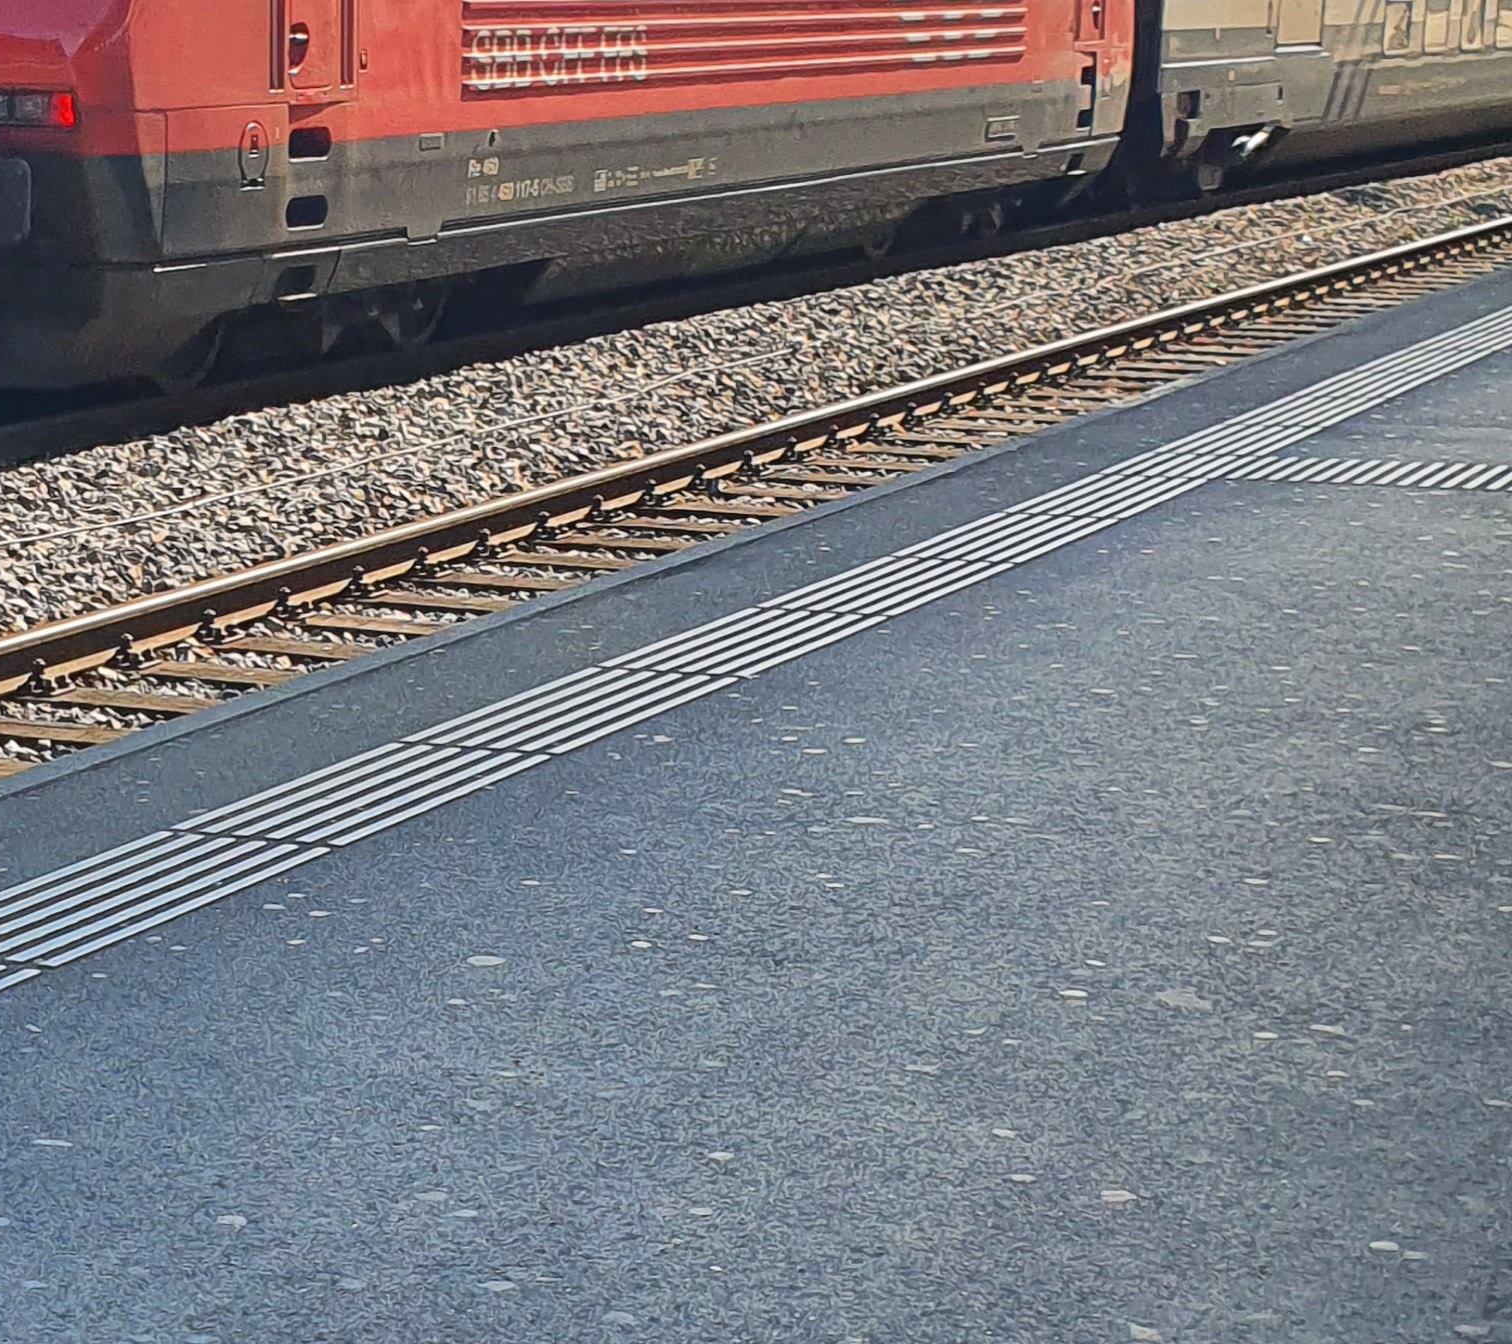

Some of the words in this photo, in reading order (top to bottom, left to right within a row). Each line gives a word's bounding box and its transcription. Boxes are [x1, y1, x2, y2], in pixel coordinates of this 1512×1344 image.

[472, 29, 533, 91] SBB
[539, 26, 597, 86] CFF
[600, 24, 649, 83] FFS
